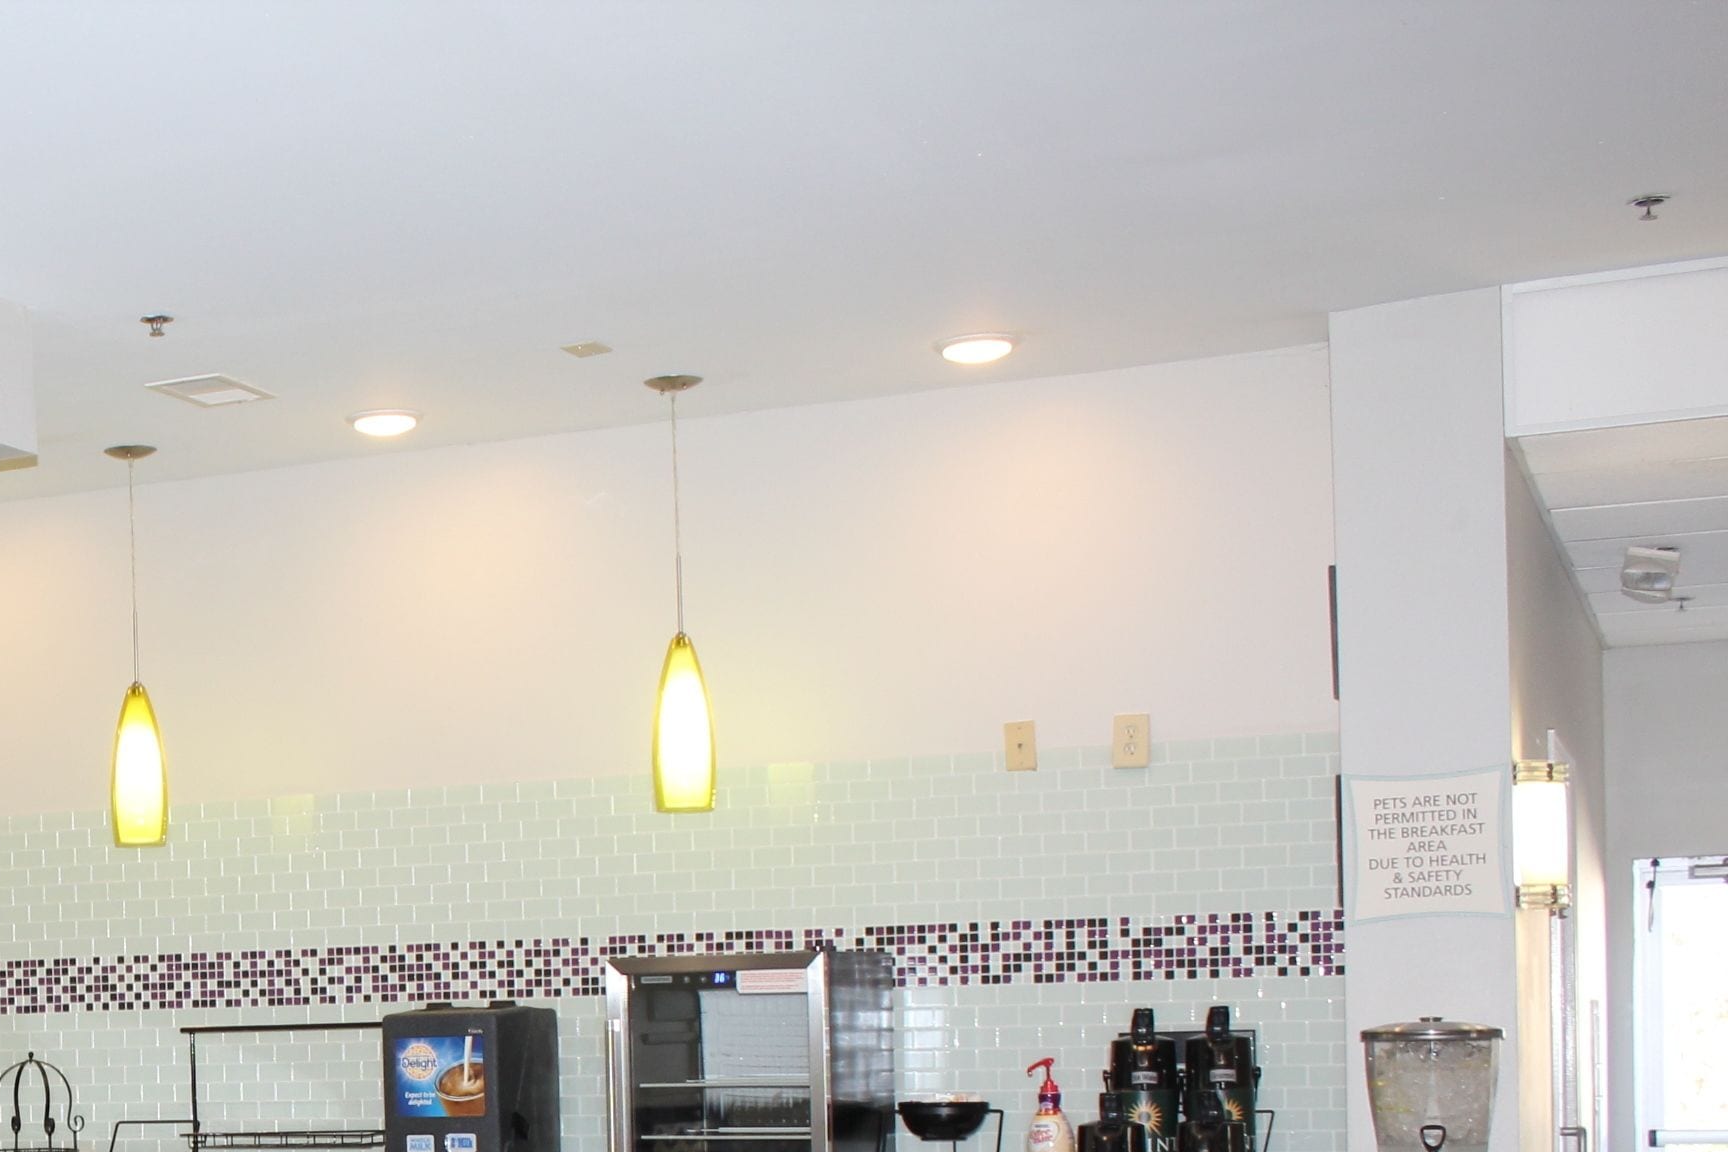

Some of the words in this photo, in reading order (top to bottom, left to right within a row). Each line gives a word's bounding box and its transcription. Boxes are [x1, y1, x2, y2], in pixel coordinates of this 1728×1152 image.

[1374, 797, 1407, 809] PETS
[1412, 795, 1441, 807] ARE
[1446, 793, 1478, 806] NOT
[1375, 809, 1457, 825] PERMITTED
[1462, 808, 1477, 820] IN
[1368, 828, 1395, 840] THE
[1401, 822, 1485, 839] BREAKFAST
[1406, 840, 1447, 853] AREA
[1368, 858, 1398, 870] DUE
[1404, 856, 1424, 868] TO
[1429, 853, 1486, 867] HEALTH
[1392, 872, 1403, 884] &
[1408, 869, 1463, 883] SAFETY
[1384, 884, 1472, 900] STANDARDS
[401, 1057, 437, 1071] Delight
